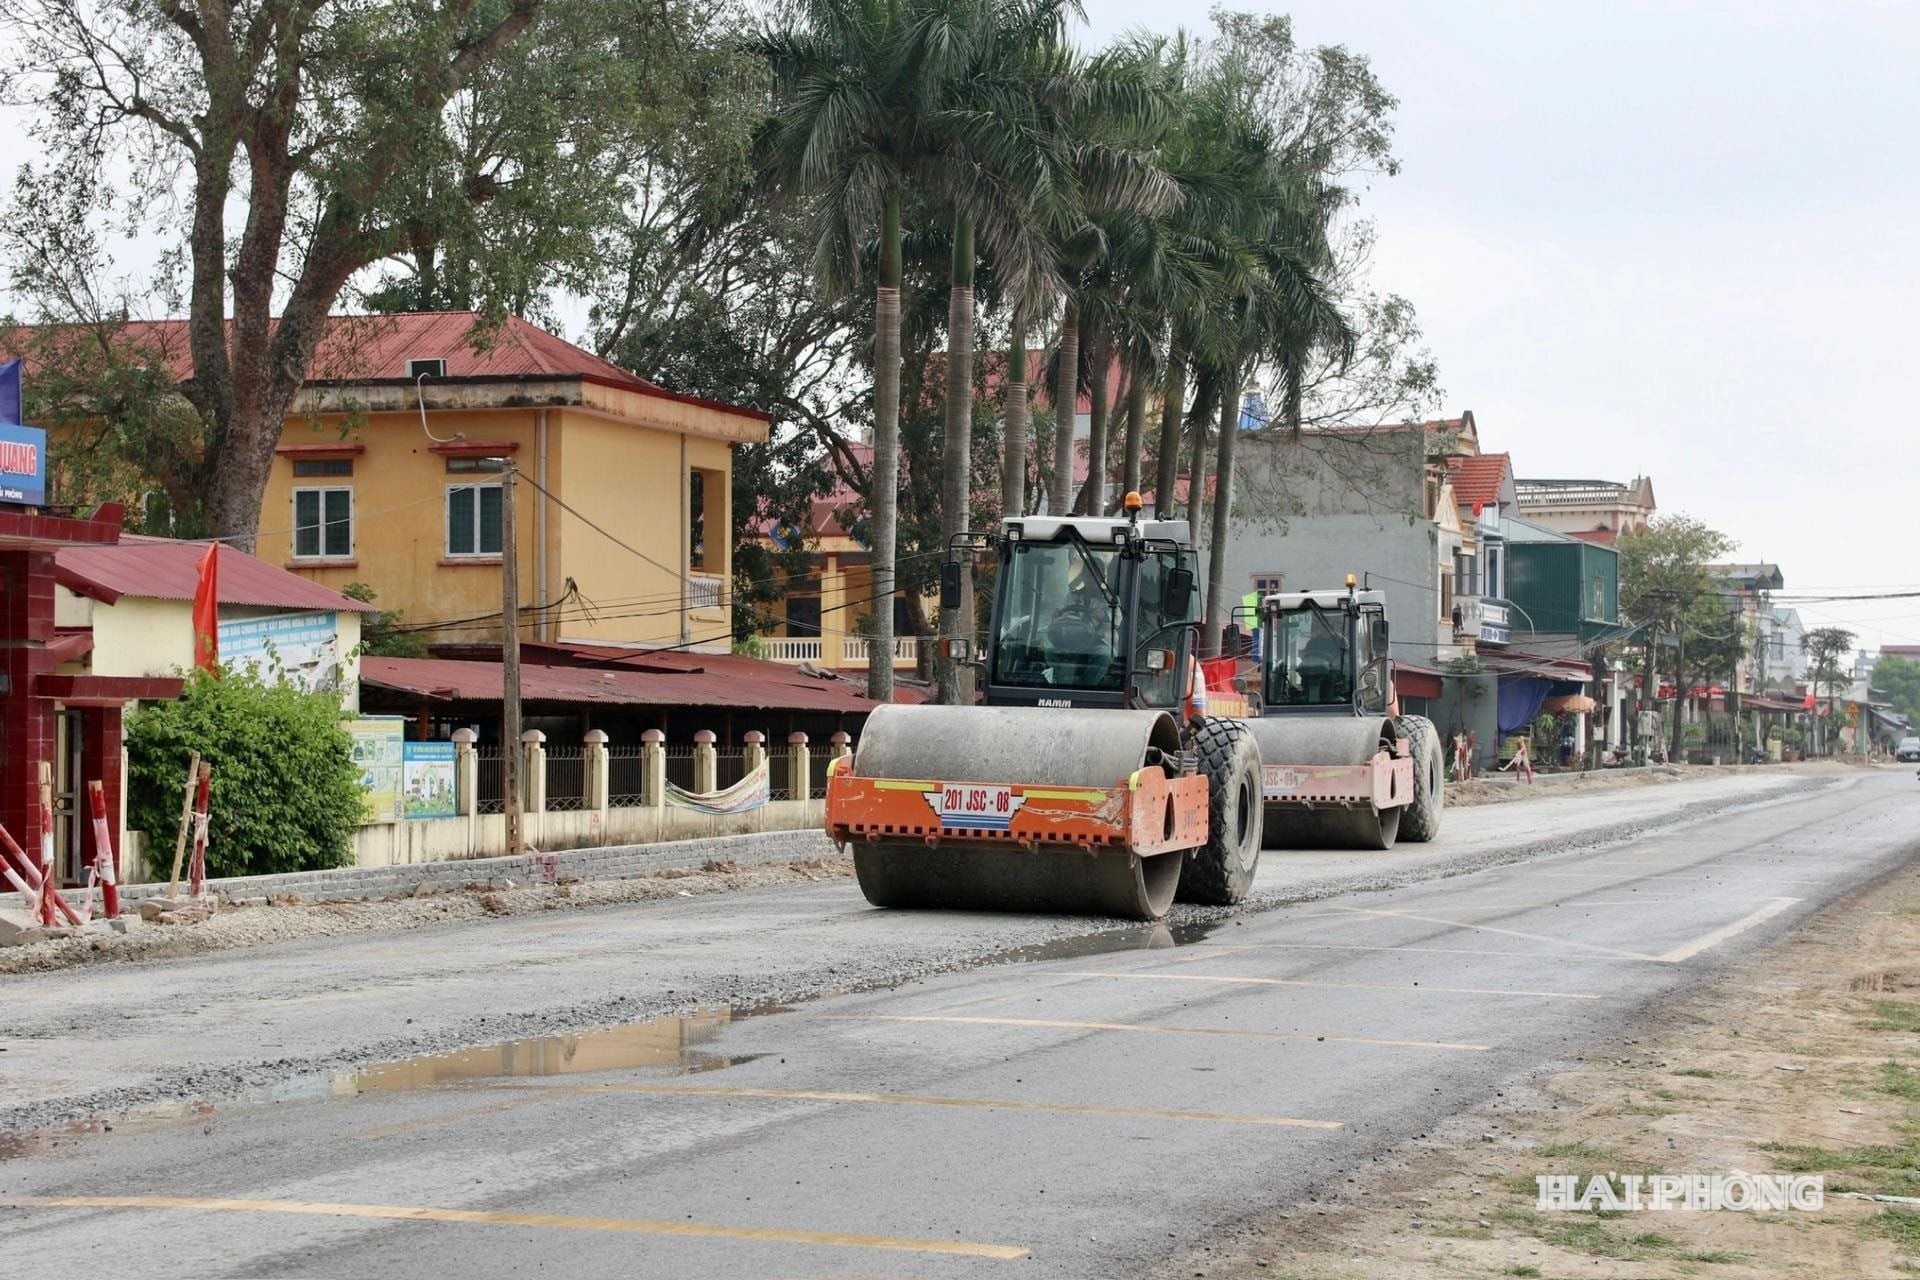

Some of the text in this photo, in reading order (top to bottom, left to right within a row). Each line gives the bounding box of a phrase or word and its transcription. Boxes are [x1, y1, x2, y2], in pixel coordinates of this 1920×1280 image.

[1038, 698, 1072, 708] HAMM
[944, 788, 962, 810] 201
[966, 790, 987, 812] JSC
[996, 791, 1010, 812] 08
